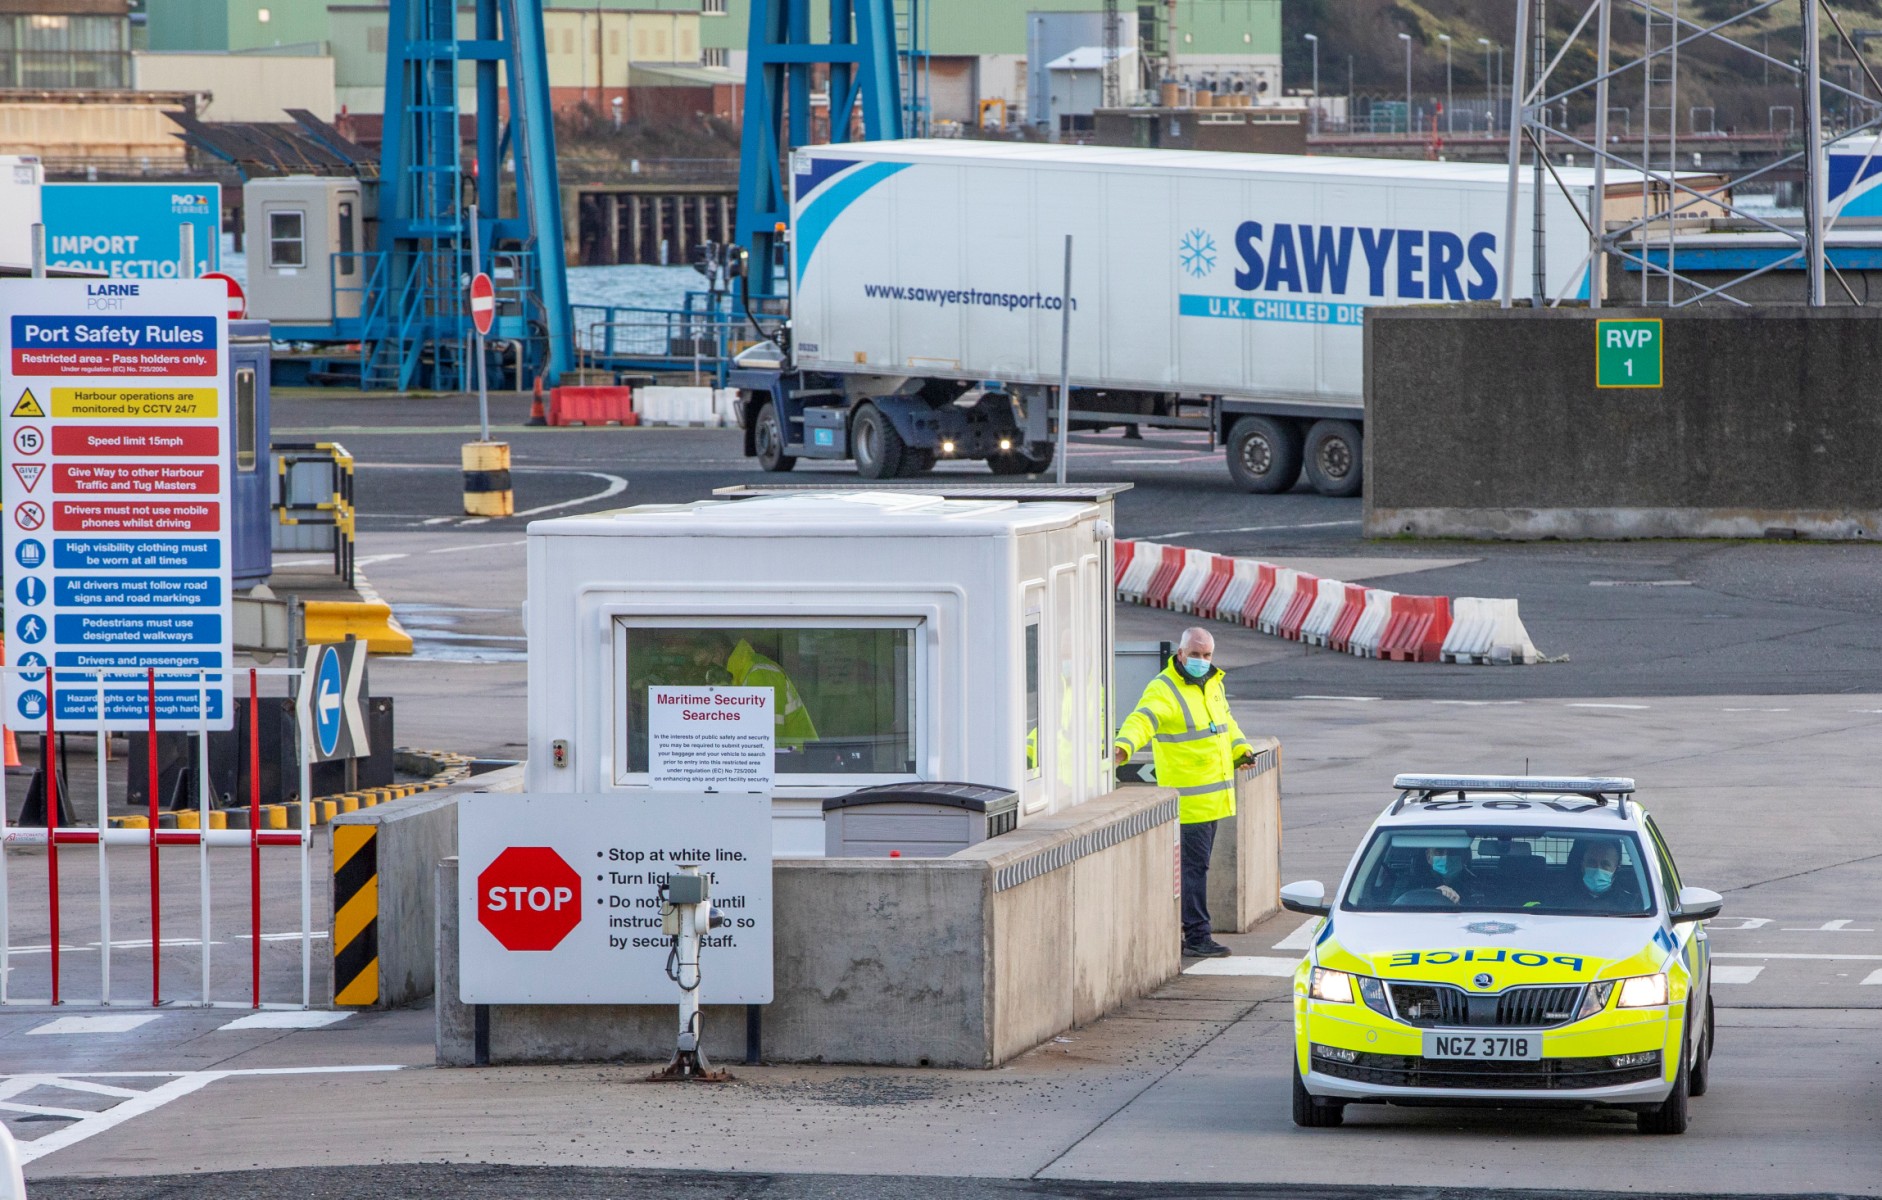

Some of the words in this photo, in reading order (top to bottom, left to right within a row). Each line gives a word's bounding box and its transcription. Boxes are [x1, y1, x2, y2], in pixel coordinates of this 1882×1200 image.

[172, 206, 209, 214] FERRIES
[54, 236, 139, 254] IMPORT
[1234, 220, 1498, 300] SAWYERS
[88, 285, 140, 296] LARNE
[88, 298, 124, 310] PORT
[1209, 298, 1246, 316] U.K.
[1254, 301, 1330, 322] CHILLED
[25, 325, 69, 342] Port
[74, 325, 140, 346] Safety
[146, 326, 204, 342] Rules
[1607, 330, 1652, 348] RVP
[22, 354, 77, 364] Restricted
[79, 356, 102, 364] area
[112, 355, 138, 364] Pass
[140, 354, 180, 364] holders
[182, 355, 207, 366] only.
[1624, 358, 1632, 376] 1
[75, 392, 116, 401] Harbour
[120, 392, 174, 403] operations
[72, 405, 125, 414] monitored
[128, 405, 140, 416] by
[142, 405, 172, 414] CCTV
[175, 405, 196, 414] 24/7
[20, 435, 36, 447] 15
[88, 436, 120, 447] Speed
[123, 436, 146, 446] limit
[148, 436, 183, 447] 15mph
[68, 468, 91, 477] Give
[94, 468, 115, 479] Way
[118, 469, 128, 477] to
[132, 468, 158, 477] other
[162, 468, 204, 478] Harbour
[76, 481, 108, 490] Traffic
[111, 481, 130, 490] and
[132, 482, 152, 492] Tug
[154, 482, 196, 490] Masters
[64, 506, 102, 514] Drivers
[104, 506, 130, 515] must
[174, 506, 208, 515] mobile
[82, 519, 120, 530] phones
[122, 518, 153, 528] whilst
[156, 519, 191, 530] driving
[67, 543, 90, 554] High
[93, 543, 135, 554] visibility
[138, 543, 178, 554] clothing
[87, 556, 100, 565] be
[144, 556, 156, 565] all
[159, 556, 188, 565] times
[67, 581, 80, 589] All
[83, 581, 119, 589] drivers
[150, 582, 181, 590] follow
[184, 581, 208, 590] road
[74, 594, 102, 604] signs
[105, 594, 124, 602] and
[127, 594, 150, 602] road
[153, 594, 201, 604] markings
[82, 619, 144, 627] Pedestrians
[83, 631, 140, 642] designated
[142, 632, 193, 642] walkways
[78, 656, 115, 665] Drivers
[118, 656, 137, 665] and
[140, 658, 199, 667] passengers
[657, 694, 710, 704] Maritime
[714, 694, 766, 708] Security
[113, 706, 142, 714] driving
[682, 710, 741, 720] Searches
[609, 848, 644, 864] Stop
[650, 849, 664, 861] at
[669, 848, 710, 861] white
[716, 848, 746, 861] line.
[609, 872, 642, 884] Turn
[487, 886, 573, 911] STOP
[610, 896, 630, 908] Do
[636, 898, 661, 908] not
[713, 896, 745, 908] until
[610, 915, 662, 927] instruc
[737, 918, 755, 928] so
[610, 935, 627, 949] by
[700, 935, 736, 947] staff.
[1436, 1037, 1476, 1056] NGZ
[1482, 1038, 1528, 1057] 3718
